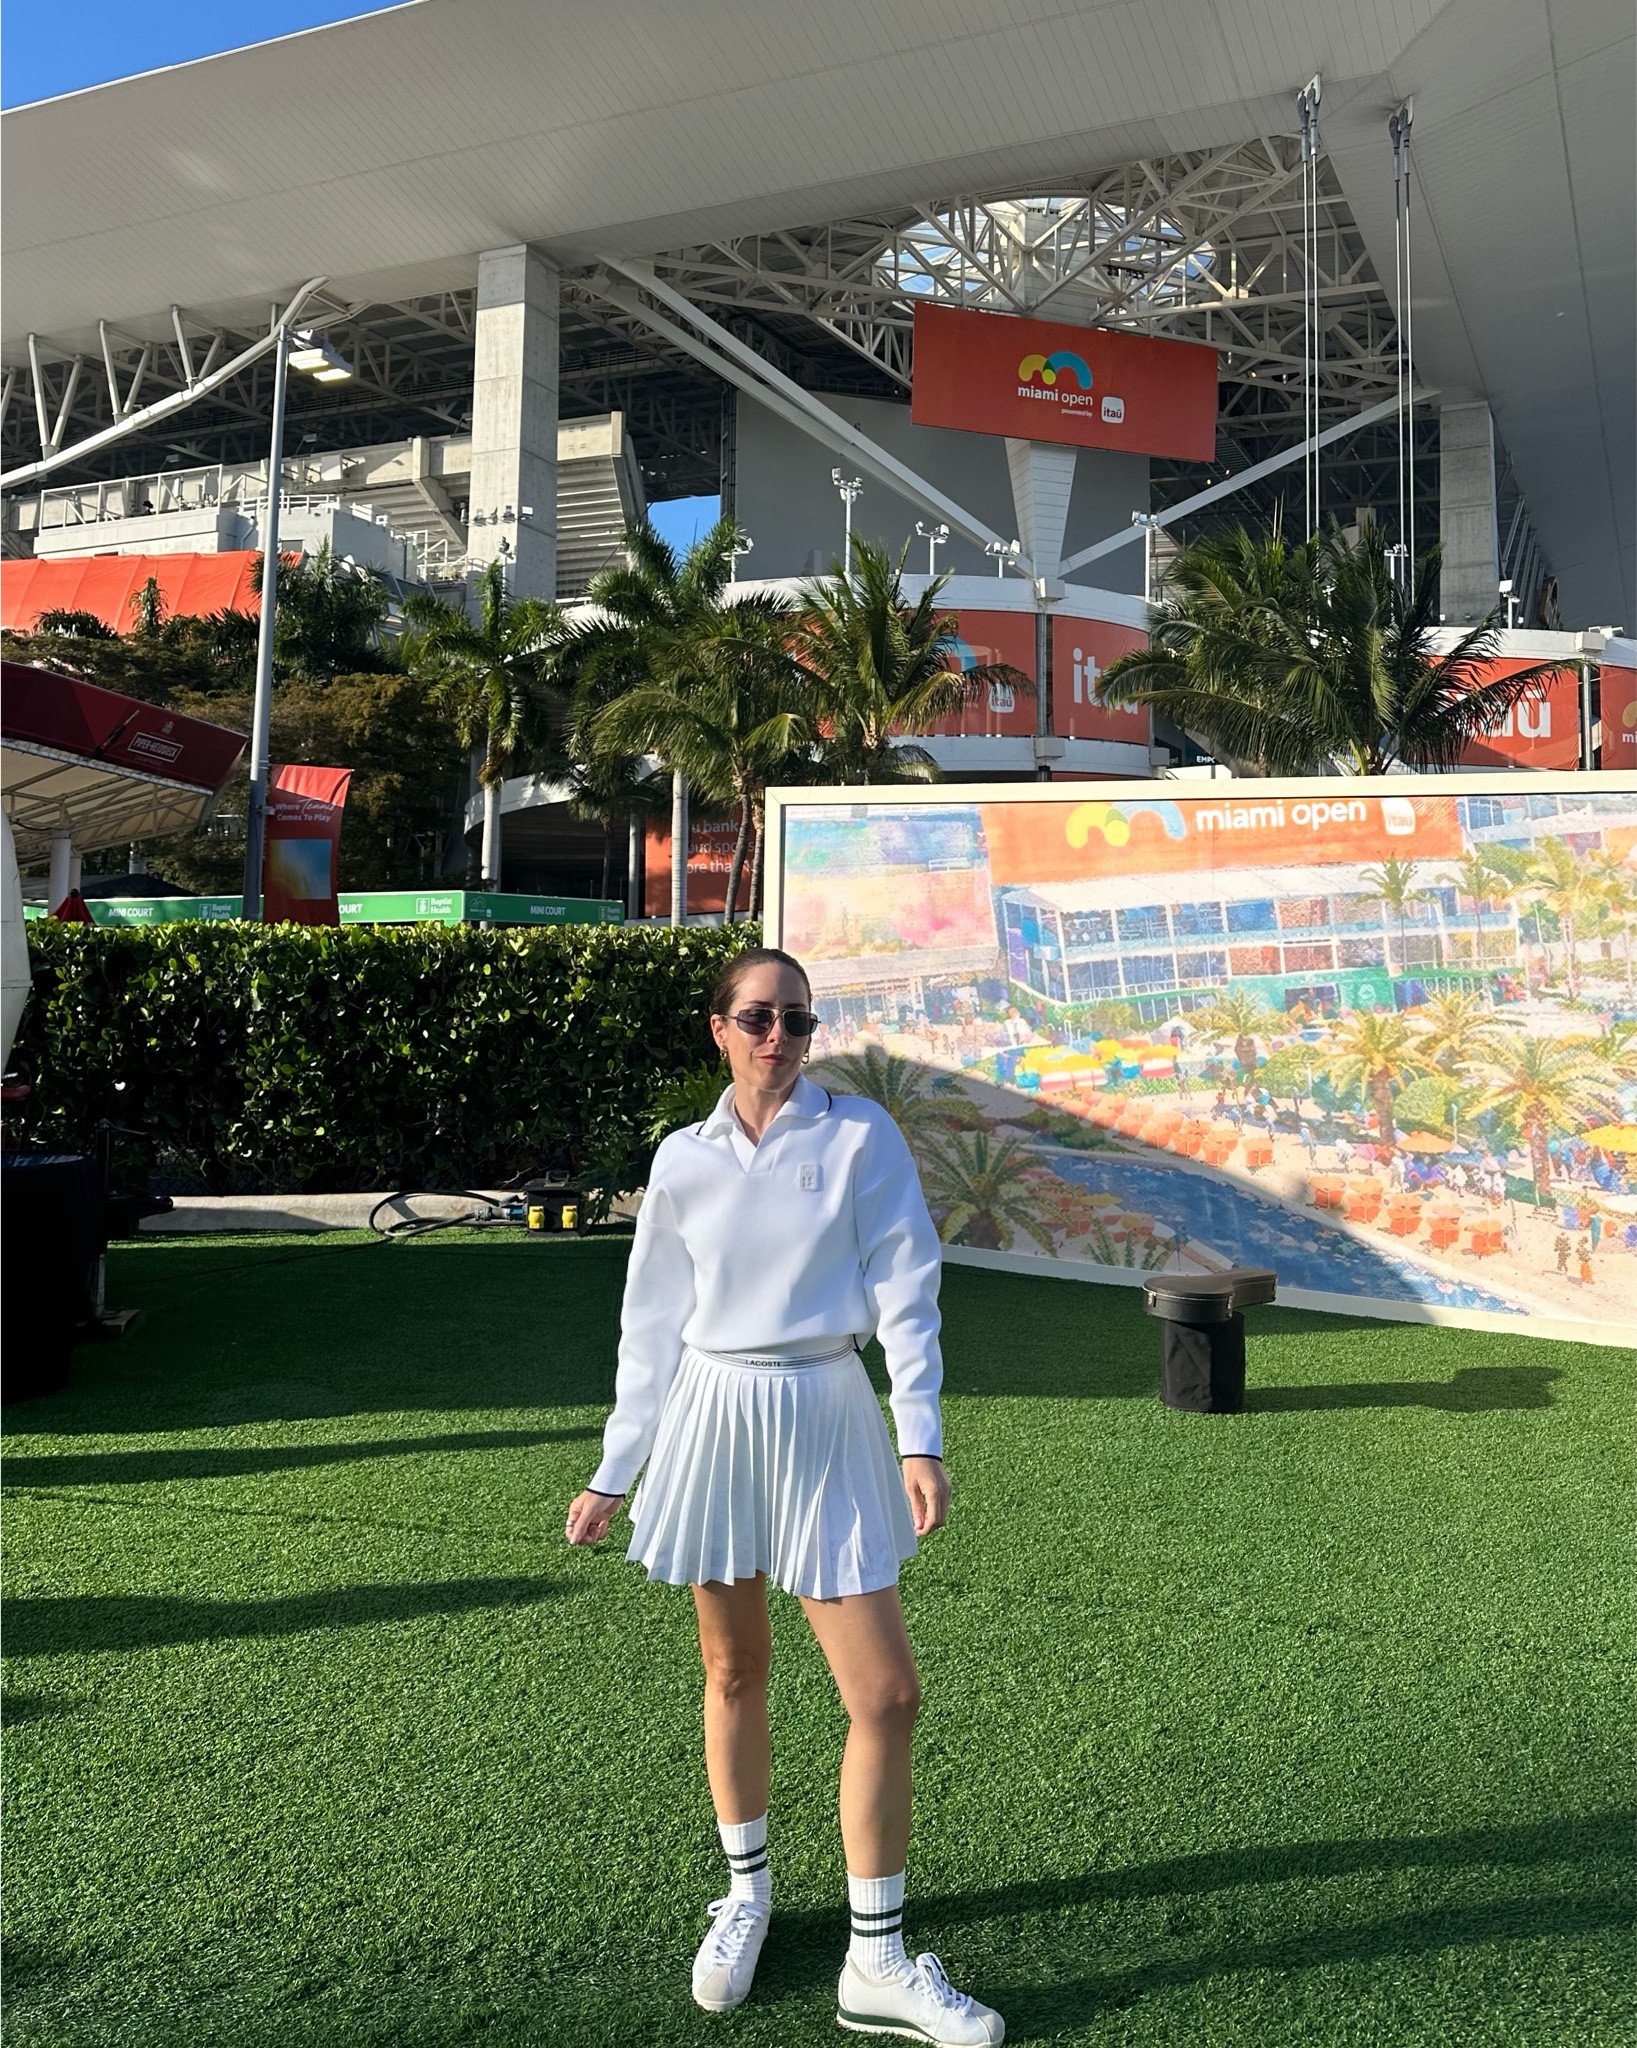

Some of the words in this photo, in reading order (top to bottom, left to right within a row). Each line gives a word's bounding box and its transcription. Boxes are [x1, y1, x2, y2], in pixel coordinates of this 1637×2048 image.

[1018, 386, 1058, 401] miami
[1061, 393, 1093, 406] open
[275, 802, 300, 811] Where
[276, 813, 302, 821] Comes
[314, 814, 332, 822] Play
[1195, 800, 1286, 831] miami
[1292, 801, 1367, 830] open
[703, 820, 739, 833] bank
[686, 862, 707, 874] ore
[108, 908, 126, 917] MINI
[127, 907, 154, 917] COURT
[338, 903, 363, 914] OURT
[530, 905, 545, 915] MINI
[545, 906, 565, 916] COURT
[745, 1359, 782, 1368] LACOSTE
